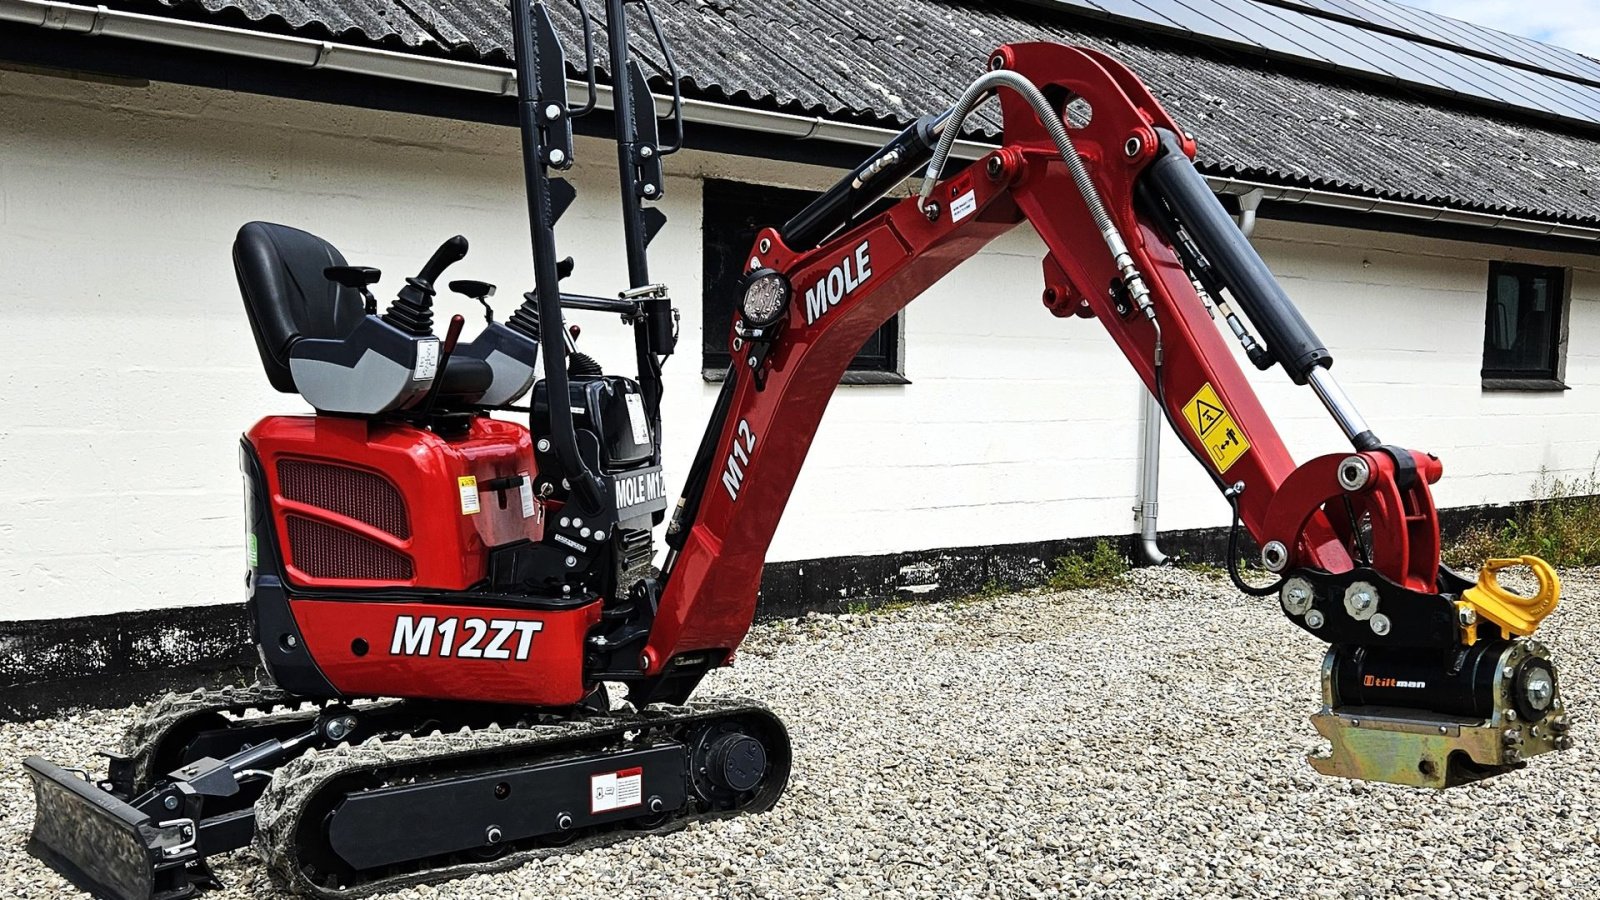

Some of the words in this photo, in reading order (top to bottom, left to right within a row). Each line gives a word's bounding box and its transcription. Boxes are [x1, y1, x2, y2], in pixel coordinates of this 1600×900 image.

[804, 240, 872, 326] MOLE
[722, 419, 756, 501] M12
[615, 475, 645, 509] MOLE
[390, 615, 543, 660] M12ZT
[1375, 678, 1426, 688] tiltman
